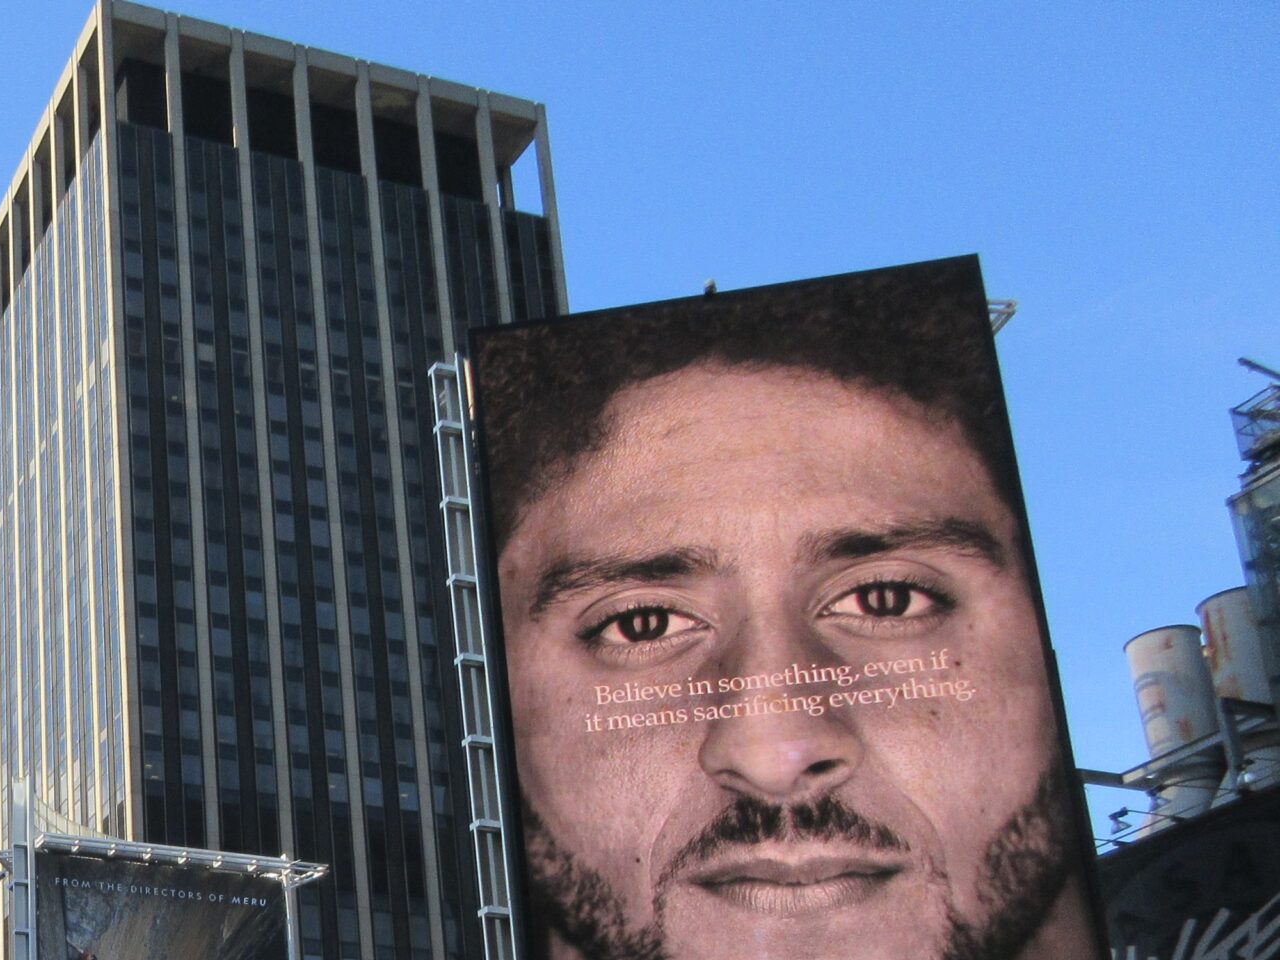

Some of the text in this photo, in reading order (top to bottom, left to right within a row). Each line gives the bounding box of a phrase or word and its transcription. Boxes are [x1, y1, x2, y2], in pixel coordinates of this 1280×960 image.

[584, 677, 978, 733] it means sacrificing everything.
[594, 649, 951, 706] Believe in something, even if
[55, 877, 267, 907] FROM THE DIRECTORS OF MERU
